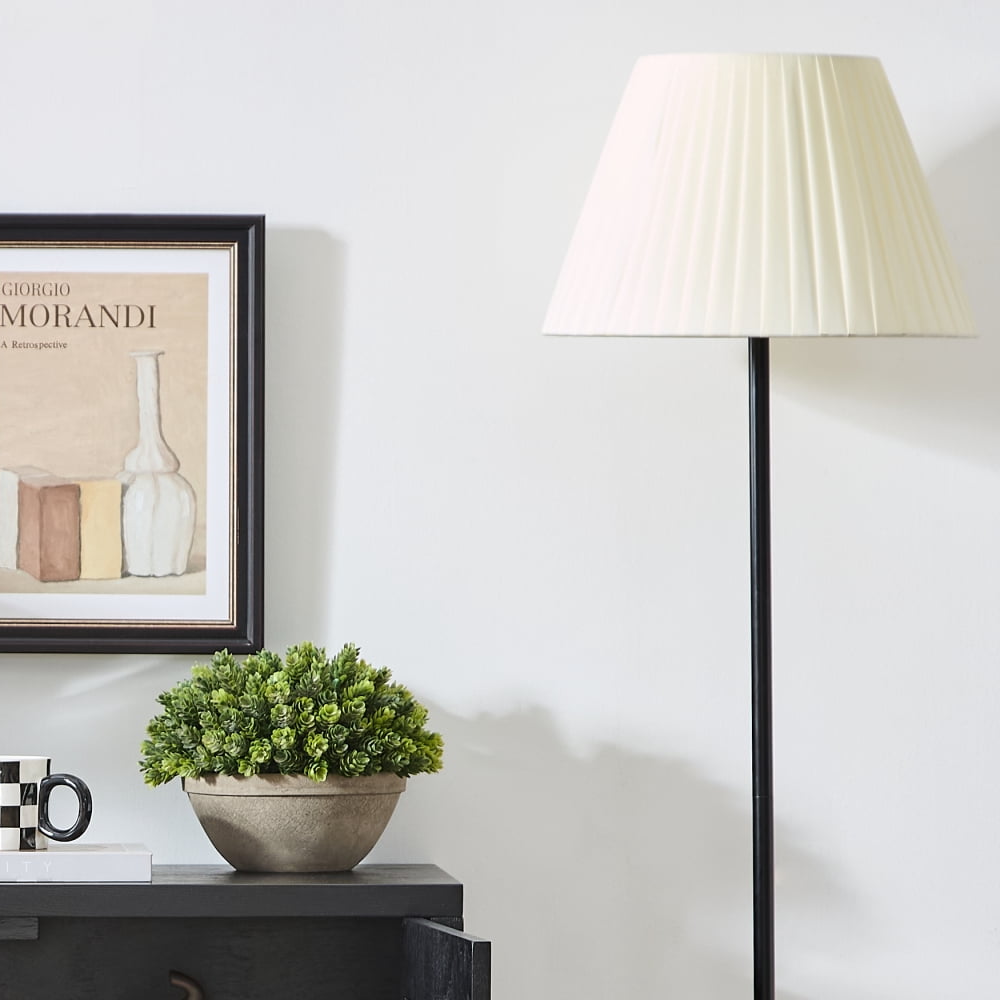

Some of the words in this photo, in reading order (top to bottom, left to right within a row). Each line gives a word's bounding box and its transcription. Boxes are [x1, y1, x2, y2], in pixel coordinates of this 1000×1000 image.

[2, 282, 70, 296] GIORGIO
[0, 303, 156, 328] MORANDI
[1, 340, 7, 349] A
[12, 340, 68, 350] Retrospective
